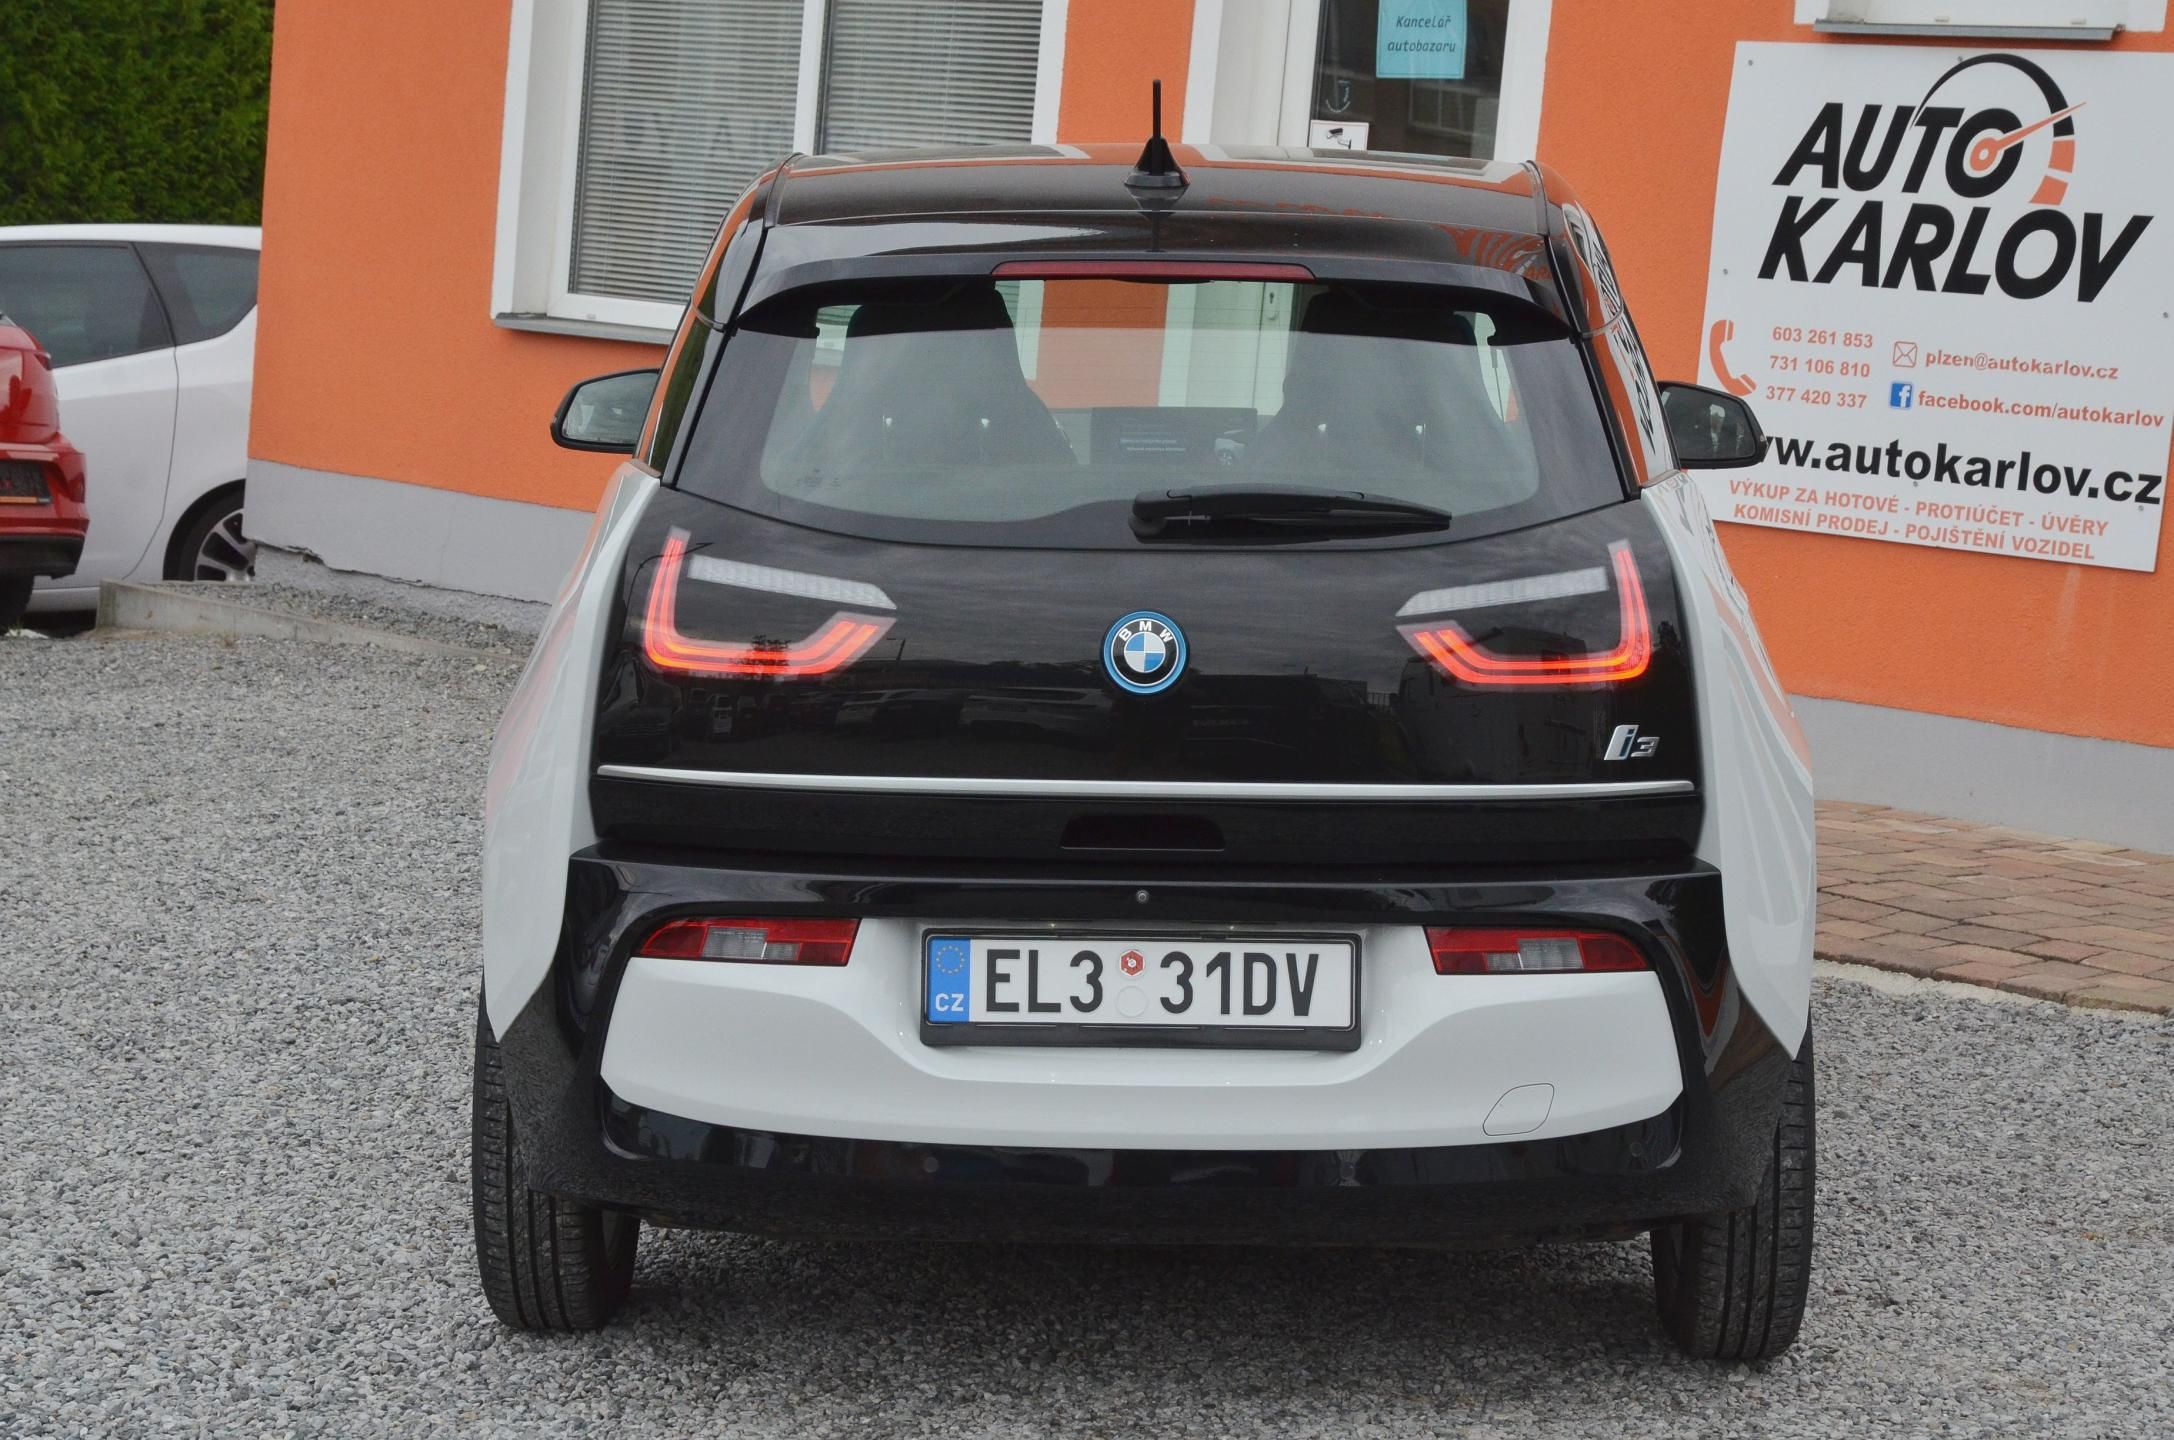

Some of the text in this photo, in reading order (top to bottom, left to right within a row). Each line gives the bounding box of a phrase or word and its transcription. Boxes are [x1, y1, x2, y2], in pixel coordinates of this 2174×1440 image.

[1387, 39, 1456, 52] autobazaru
[1772, 102, 2023, 199] AUTO
[1757, 195, 2154, 303] KARLOV
[1772, 326, 1873, 349] 603 261 853
[1769, 354, 1871, 378] 731 106 810
[1925, 350, 2119, 380] plzen@autokarlov.cz
[1766, 385, 1868, 409] 377 420 337
[1918, 390, 2164, 428] facebook.com/autokarlov
[1763, 435, 2162, 505] w.autokarlov.cz
[1729, 478, 1790, 500] VÝKUP
[1794, 487, 1818, 505] ZA
[1824, 490, 1900, 514] HOTOVÉ
[1915, 500, 2024, 528] PROTIÚČET
[2041, 511, 2109, 537] ÚVĚRY
[1734, 503, 1811, 526] KOMISNÍ
[1816, 513, 1889, 536] PRODEJ
[1905, 524, 2006, 550] POJIŠTĚNÍ
[2012, 535, 2095, 560] VOZIDEL
[1118, 620, 1174, 643] BMW
[1604, 724, 1660, 760] i3
[986, 949, 1319, 1017] EL3 31DV
[935, 993, 965, 1013] CZ
